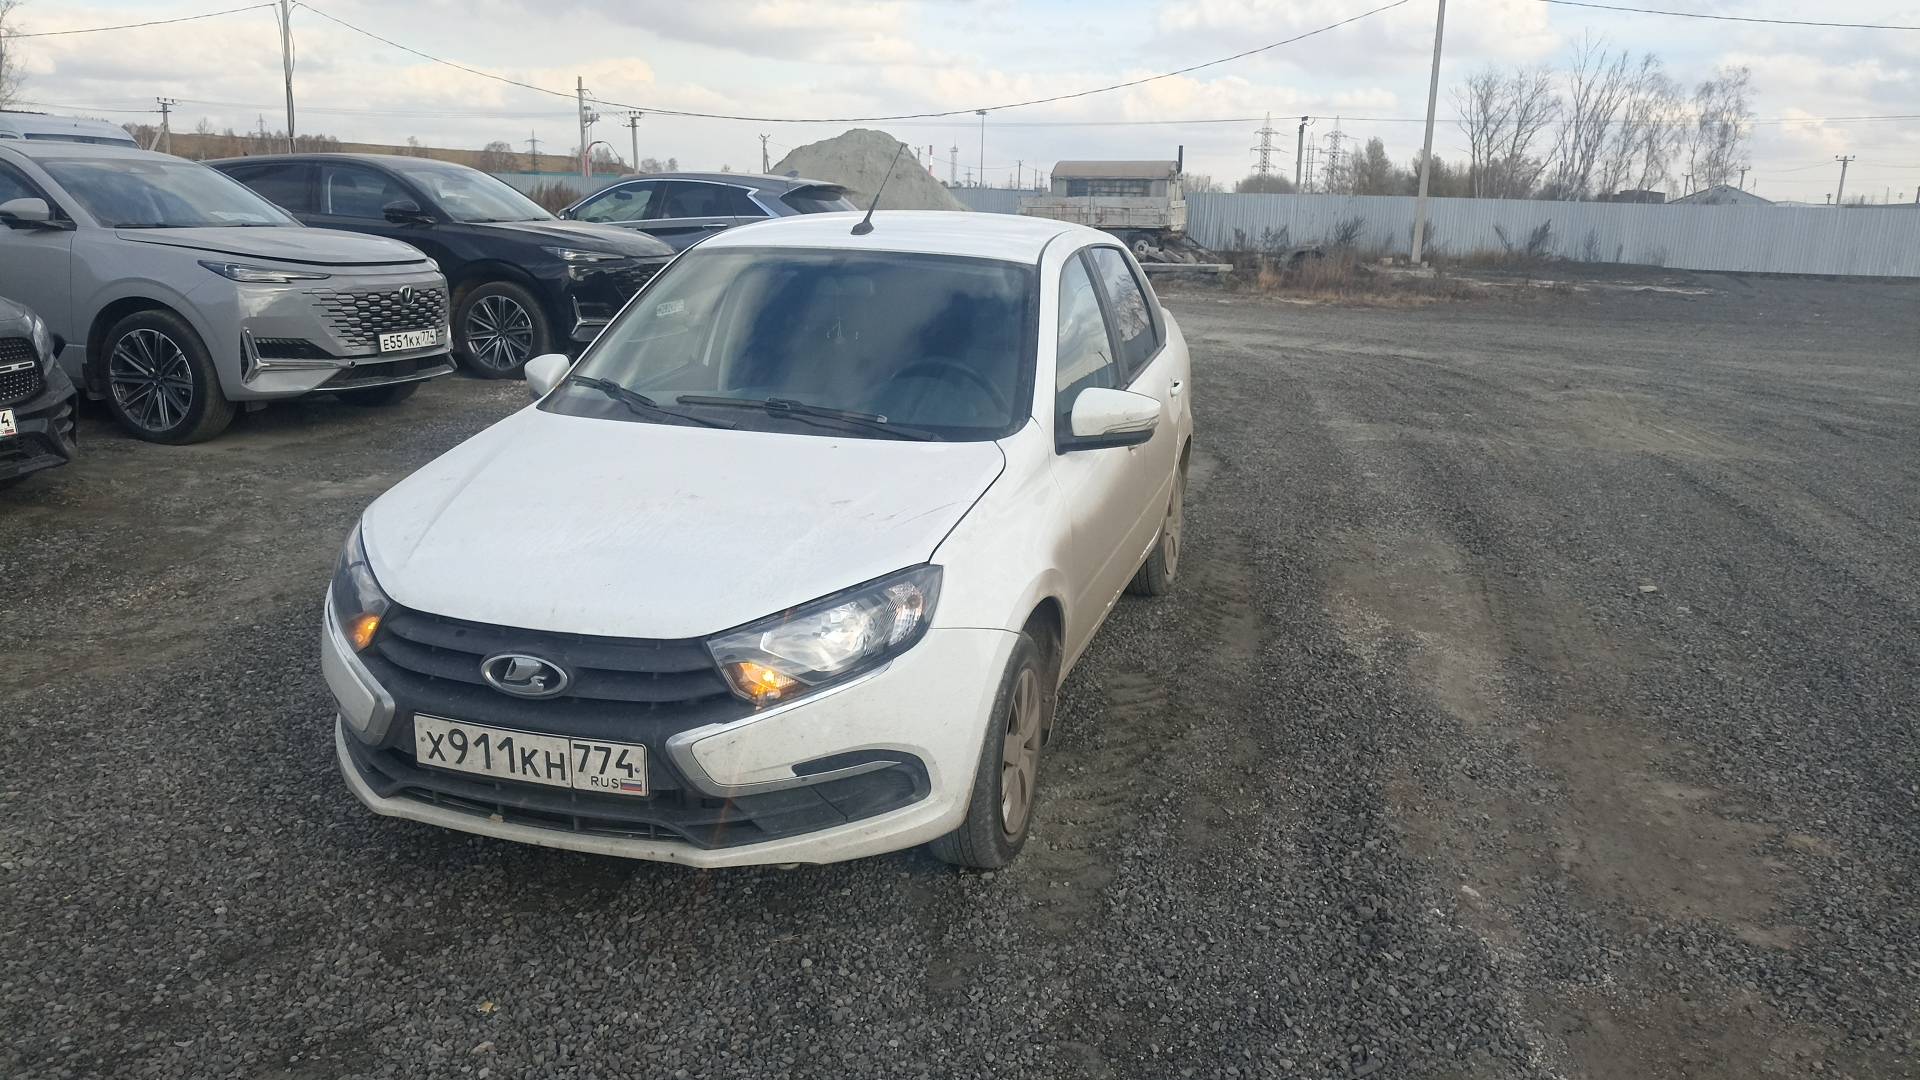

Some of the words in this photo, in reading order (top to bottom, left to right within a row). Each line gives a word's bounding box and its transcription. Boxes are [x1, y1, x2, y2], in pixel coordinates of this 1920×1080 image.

[422, 331, 435, 341] 774
[426, 728, 566, 781] Х911КН
[573, 743, 634, 778] 774
[590, 775, 619, 789] RUS
